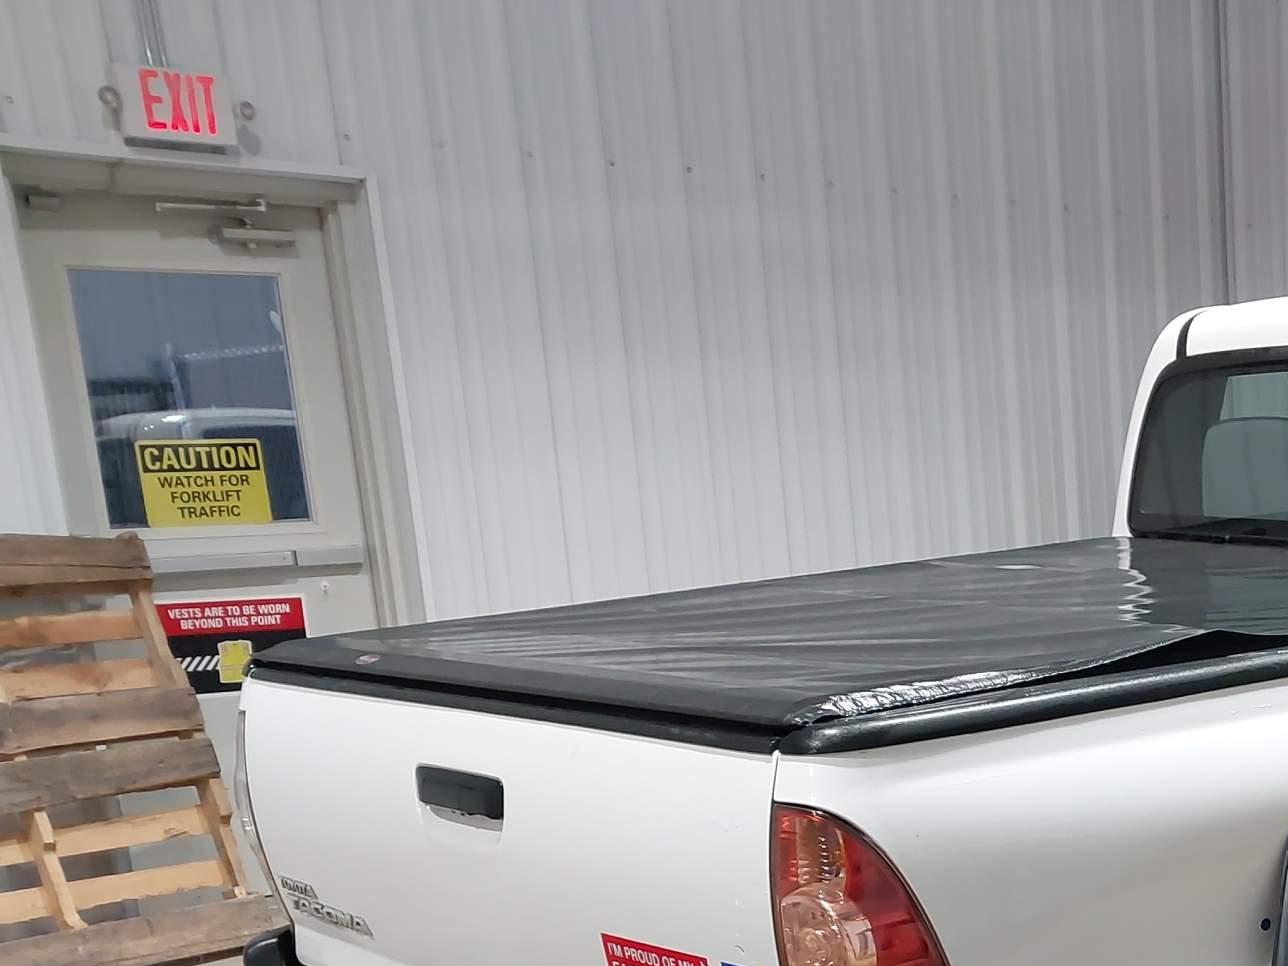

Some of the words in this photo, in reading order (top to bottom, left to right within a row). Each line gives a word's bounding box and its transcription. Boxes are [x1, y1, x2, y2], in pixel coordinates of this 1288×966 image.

[139, 69, 216, 134] EXIT
[143, 445, 257, 470] CAUTION
[158, 474, 214, 488] WATCH
[219, 474, 250, 487] FOR
[170, 489, 242, 504] FORKLIFT
[177, 504, 241, 519] TRAFFIC
[168, 608, 201, 619] VESTS
[204, 607, 224, 617] ARE
[227, 606, 240, 616] TO
[243, 605, 256, 615] BE
[257, 603, 290, 614] WORN
[180, 618, 223, 630] BEYOND
[225, 616, 249, 627] THIS
[251, 615, 282, 626] POINT
[607, 942, 623, 958] I'M
[624, 946, 660, 966] PROUD
